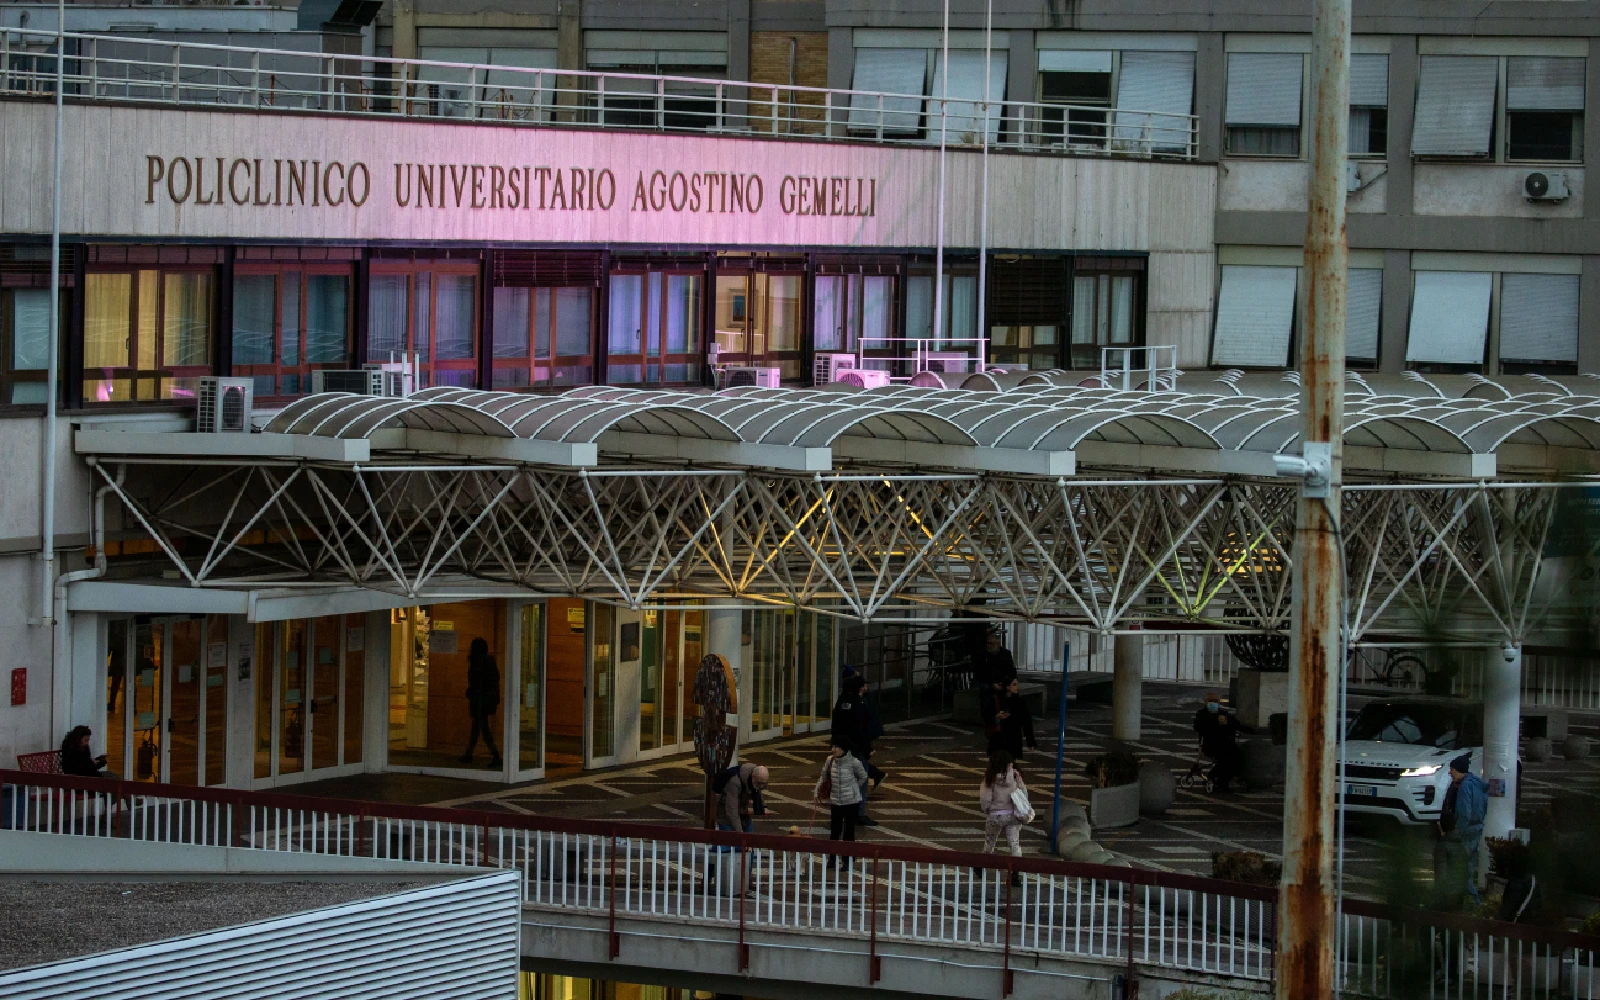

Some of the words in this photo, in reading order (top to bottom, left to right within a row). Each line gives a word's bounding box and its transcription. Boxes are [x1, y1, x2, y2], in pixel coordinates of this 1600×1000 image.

[145, 154, 371, 207] POLICLINICO
[394, 163, 616, 211] UNIVERSITARIO
[631, 169, 764, 214] AGOSTINO
[779, 174, 876, 217] GEMELLI
